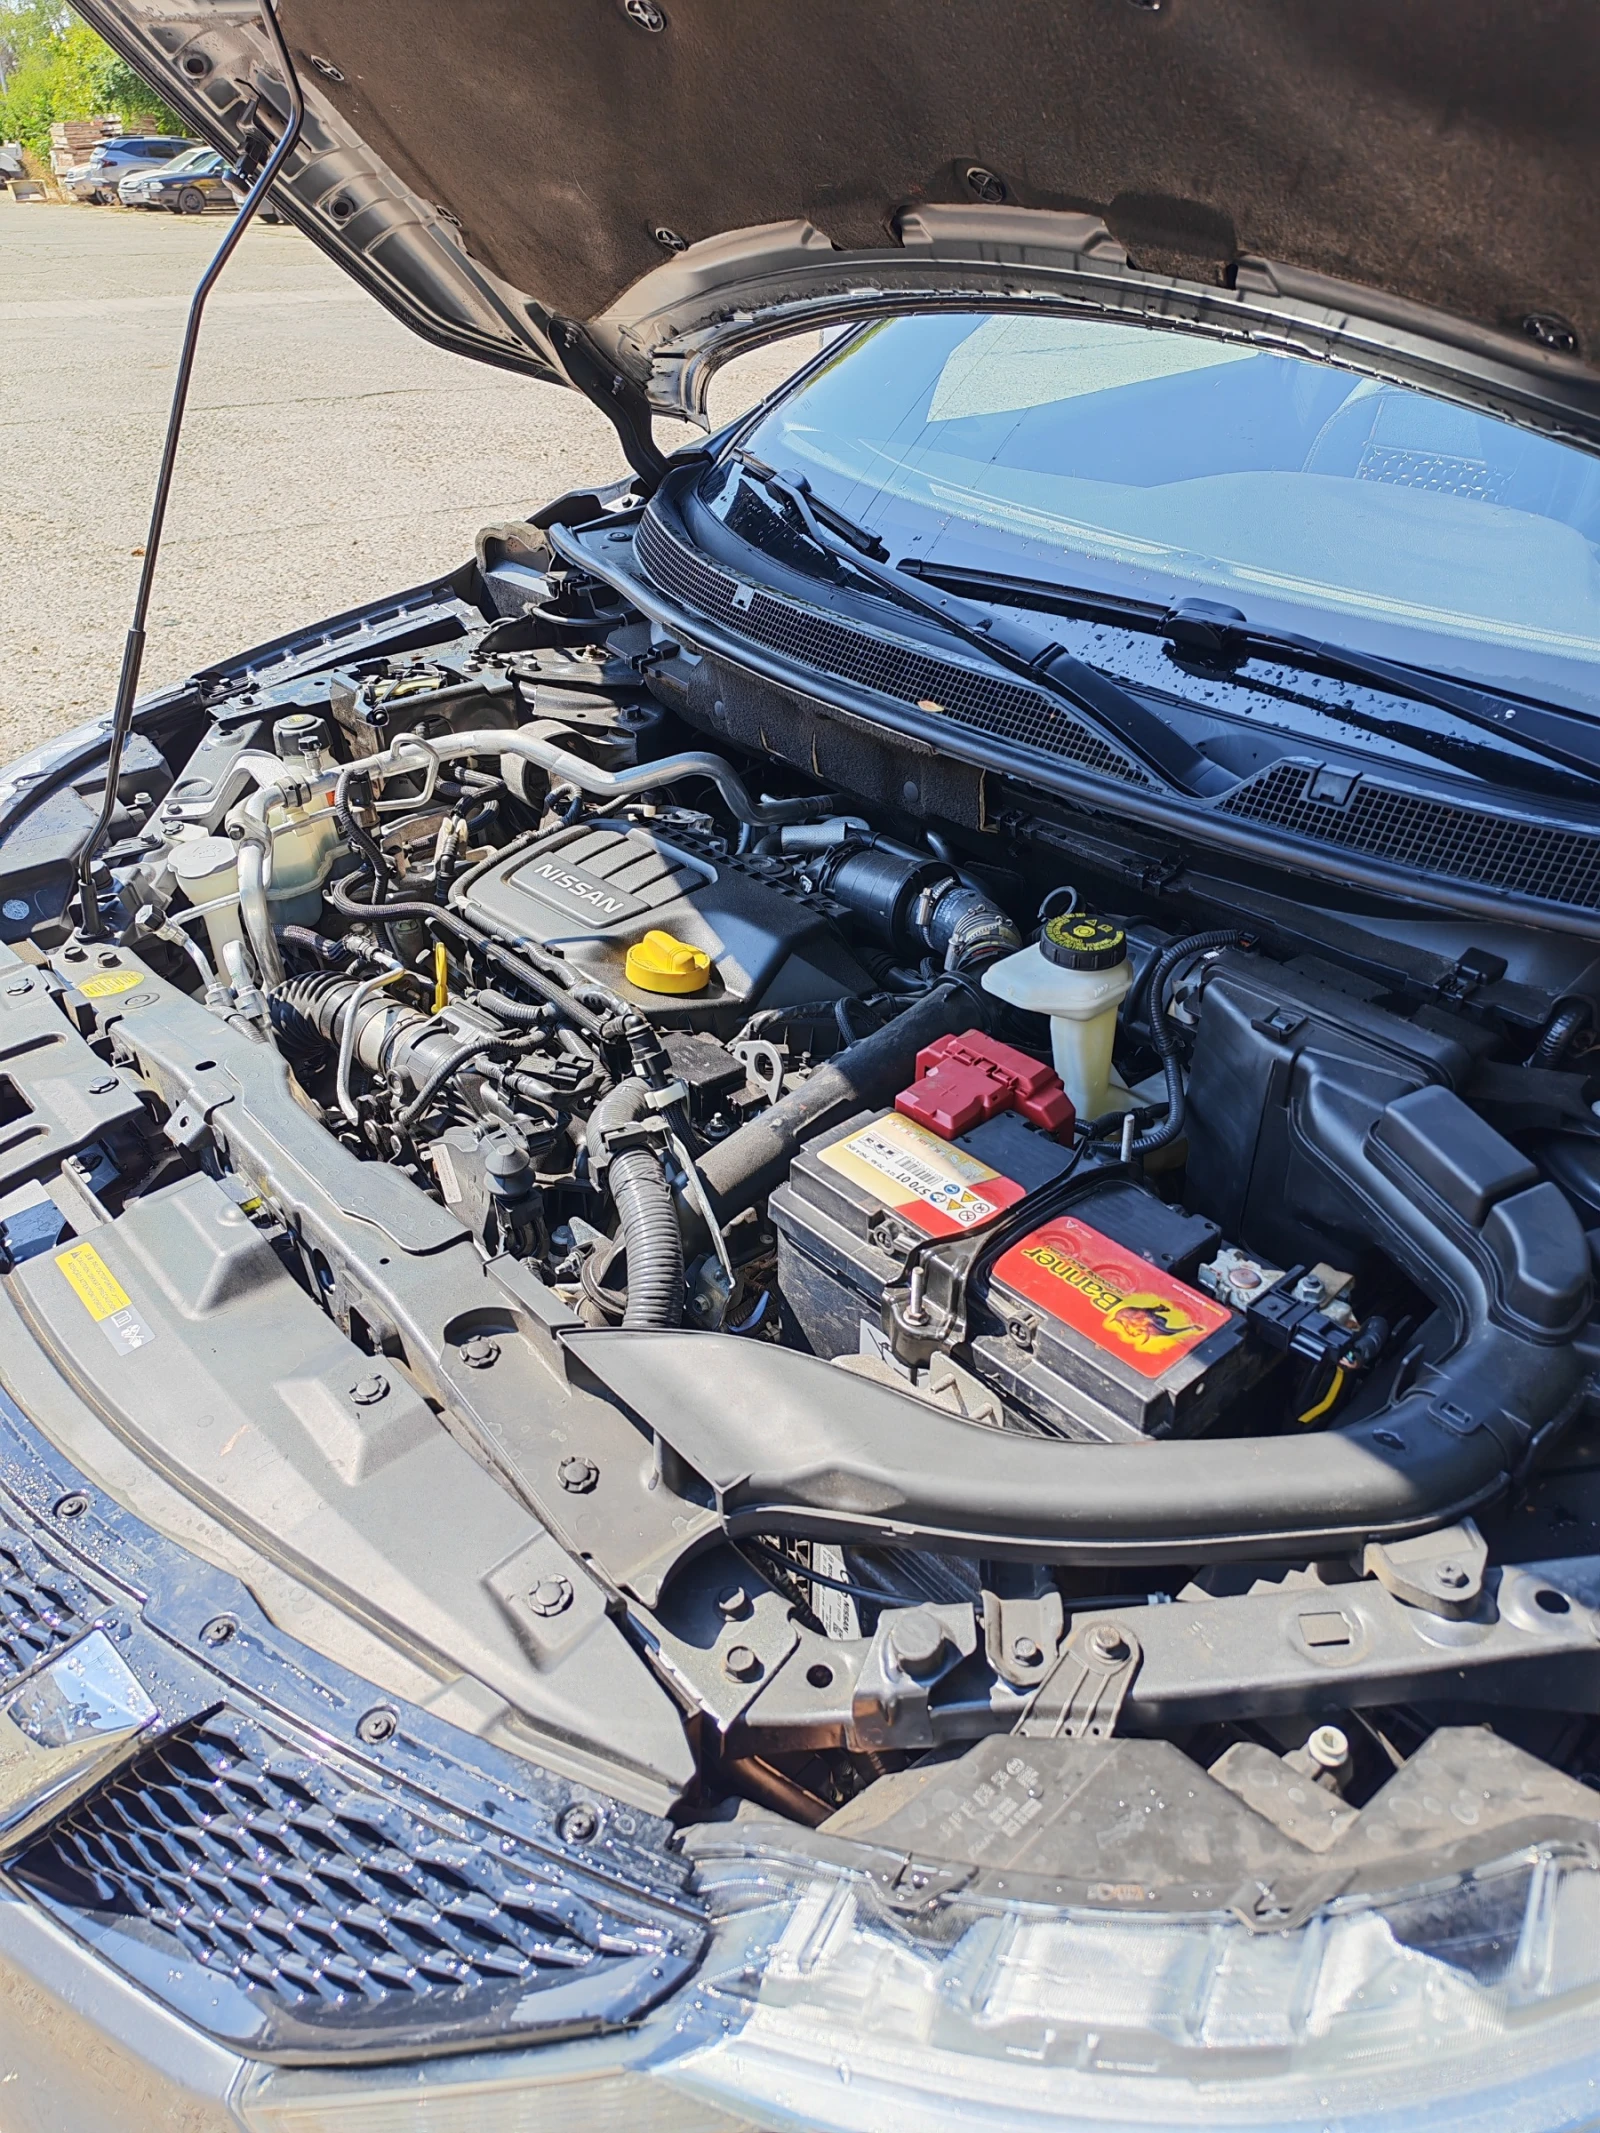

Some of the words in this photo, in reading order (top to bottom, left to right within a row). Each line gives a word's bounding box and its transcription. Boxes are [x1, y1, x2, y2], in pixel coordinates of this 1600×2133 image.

[534, 864, 624, 914] NISSAN
[895, 1172, 911, 1183] 01
[909, 1183, 931, 1195] 570
[1023, 1248, 1123, 1311] Banner
[1088, 1270, 1125, 1294] RUNNING
